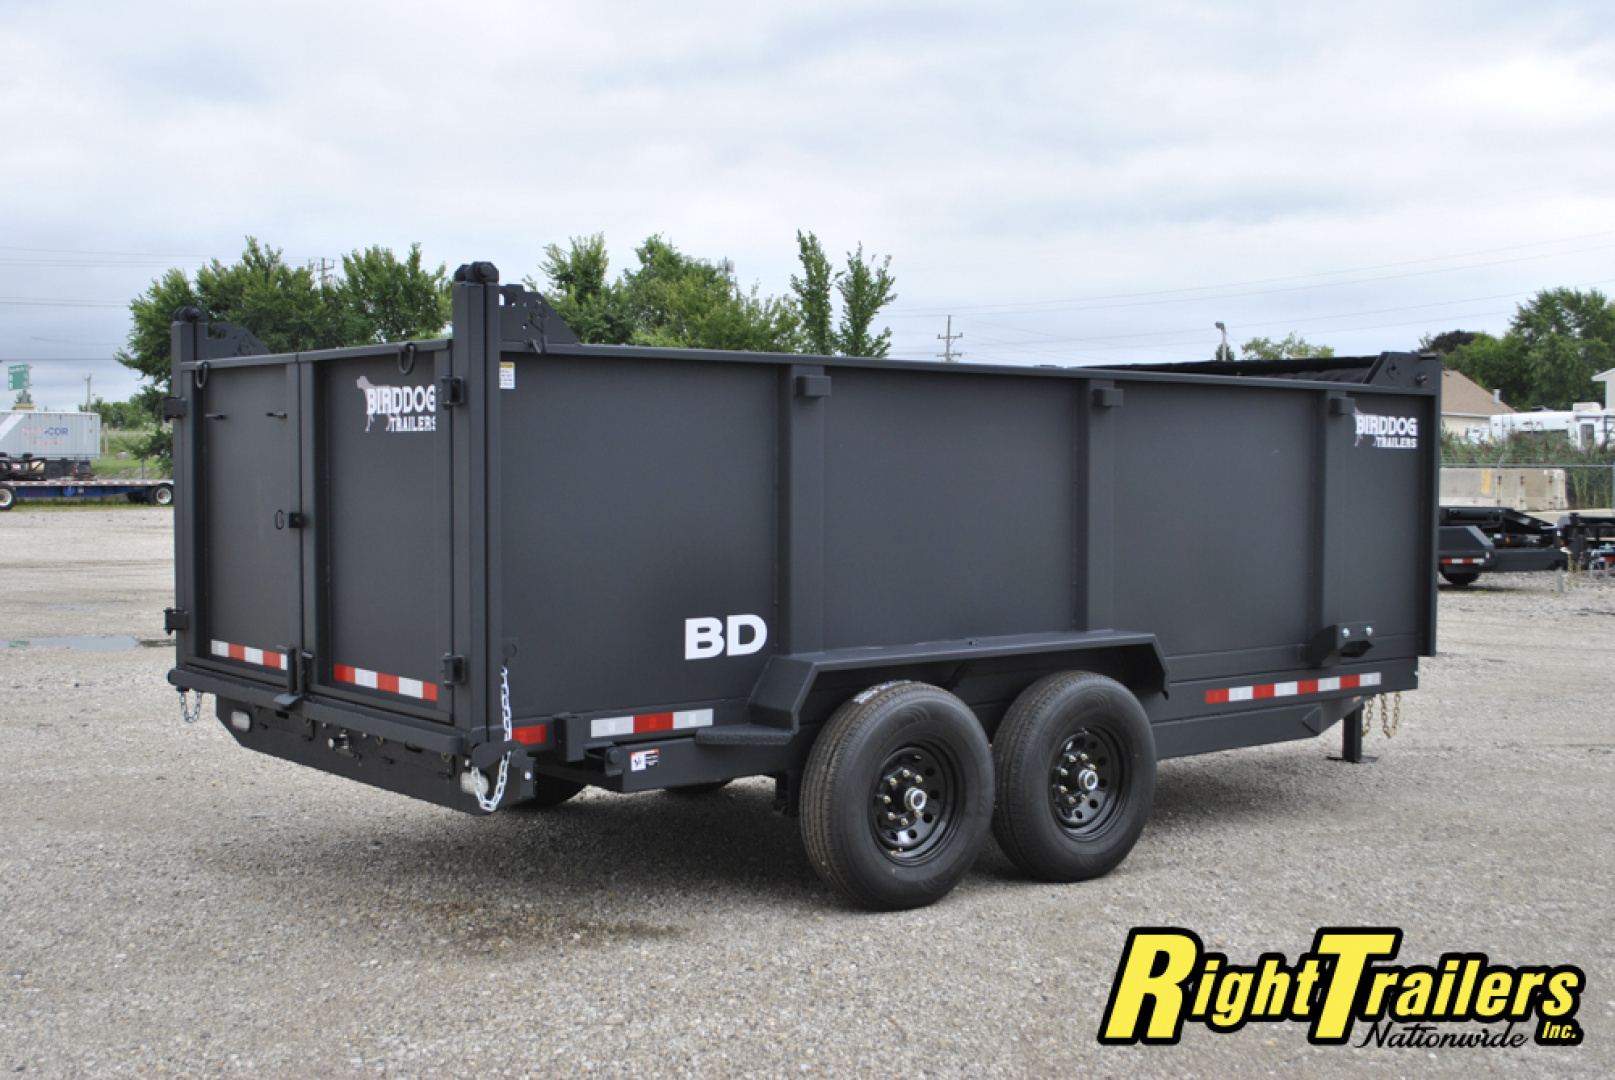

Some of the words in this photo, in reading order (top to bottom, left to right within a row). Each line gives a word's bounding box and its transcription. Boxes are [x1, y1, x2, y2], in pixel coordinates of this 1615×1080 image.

[366, 385, 436, 415] BIRDDOG
[1355, 415, 1418, 436] BIRDDOG
[1376, 437, 1418, 448] TRAILERS
[685, 613, 768, 660] BD
